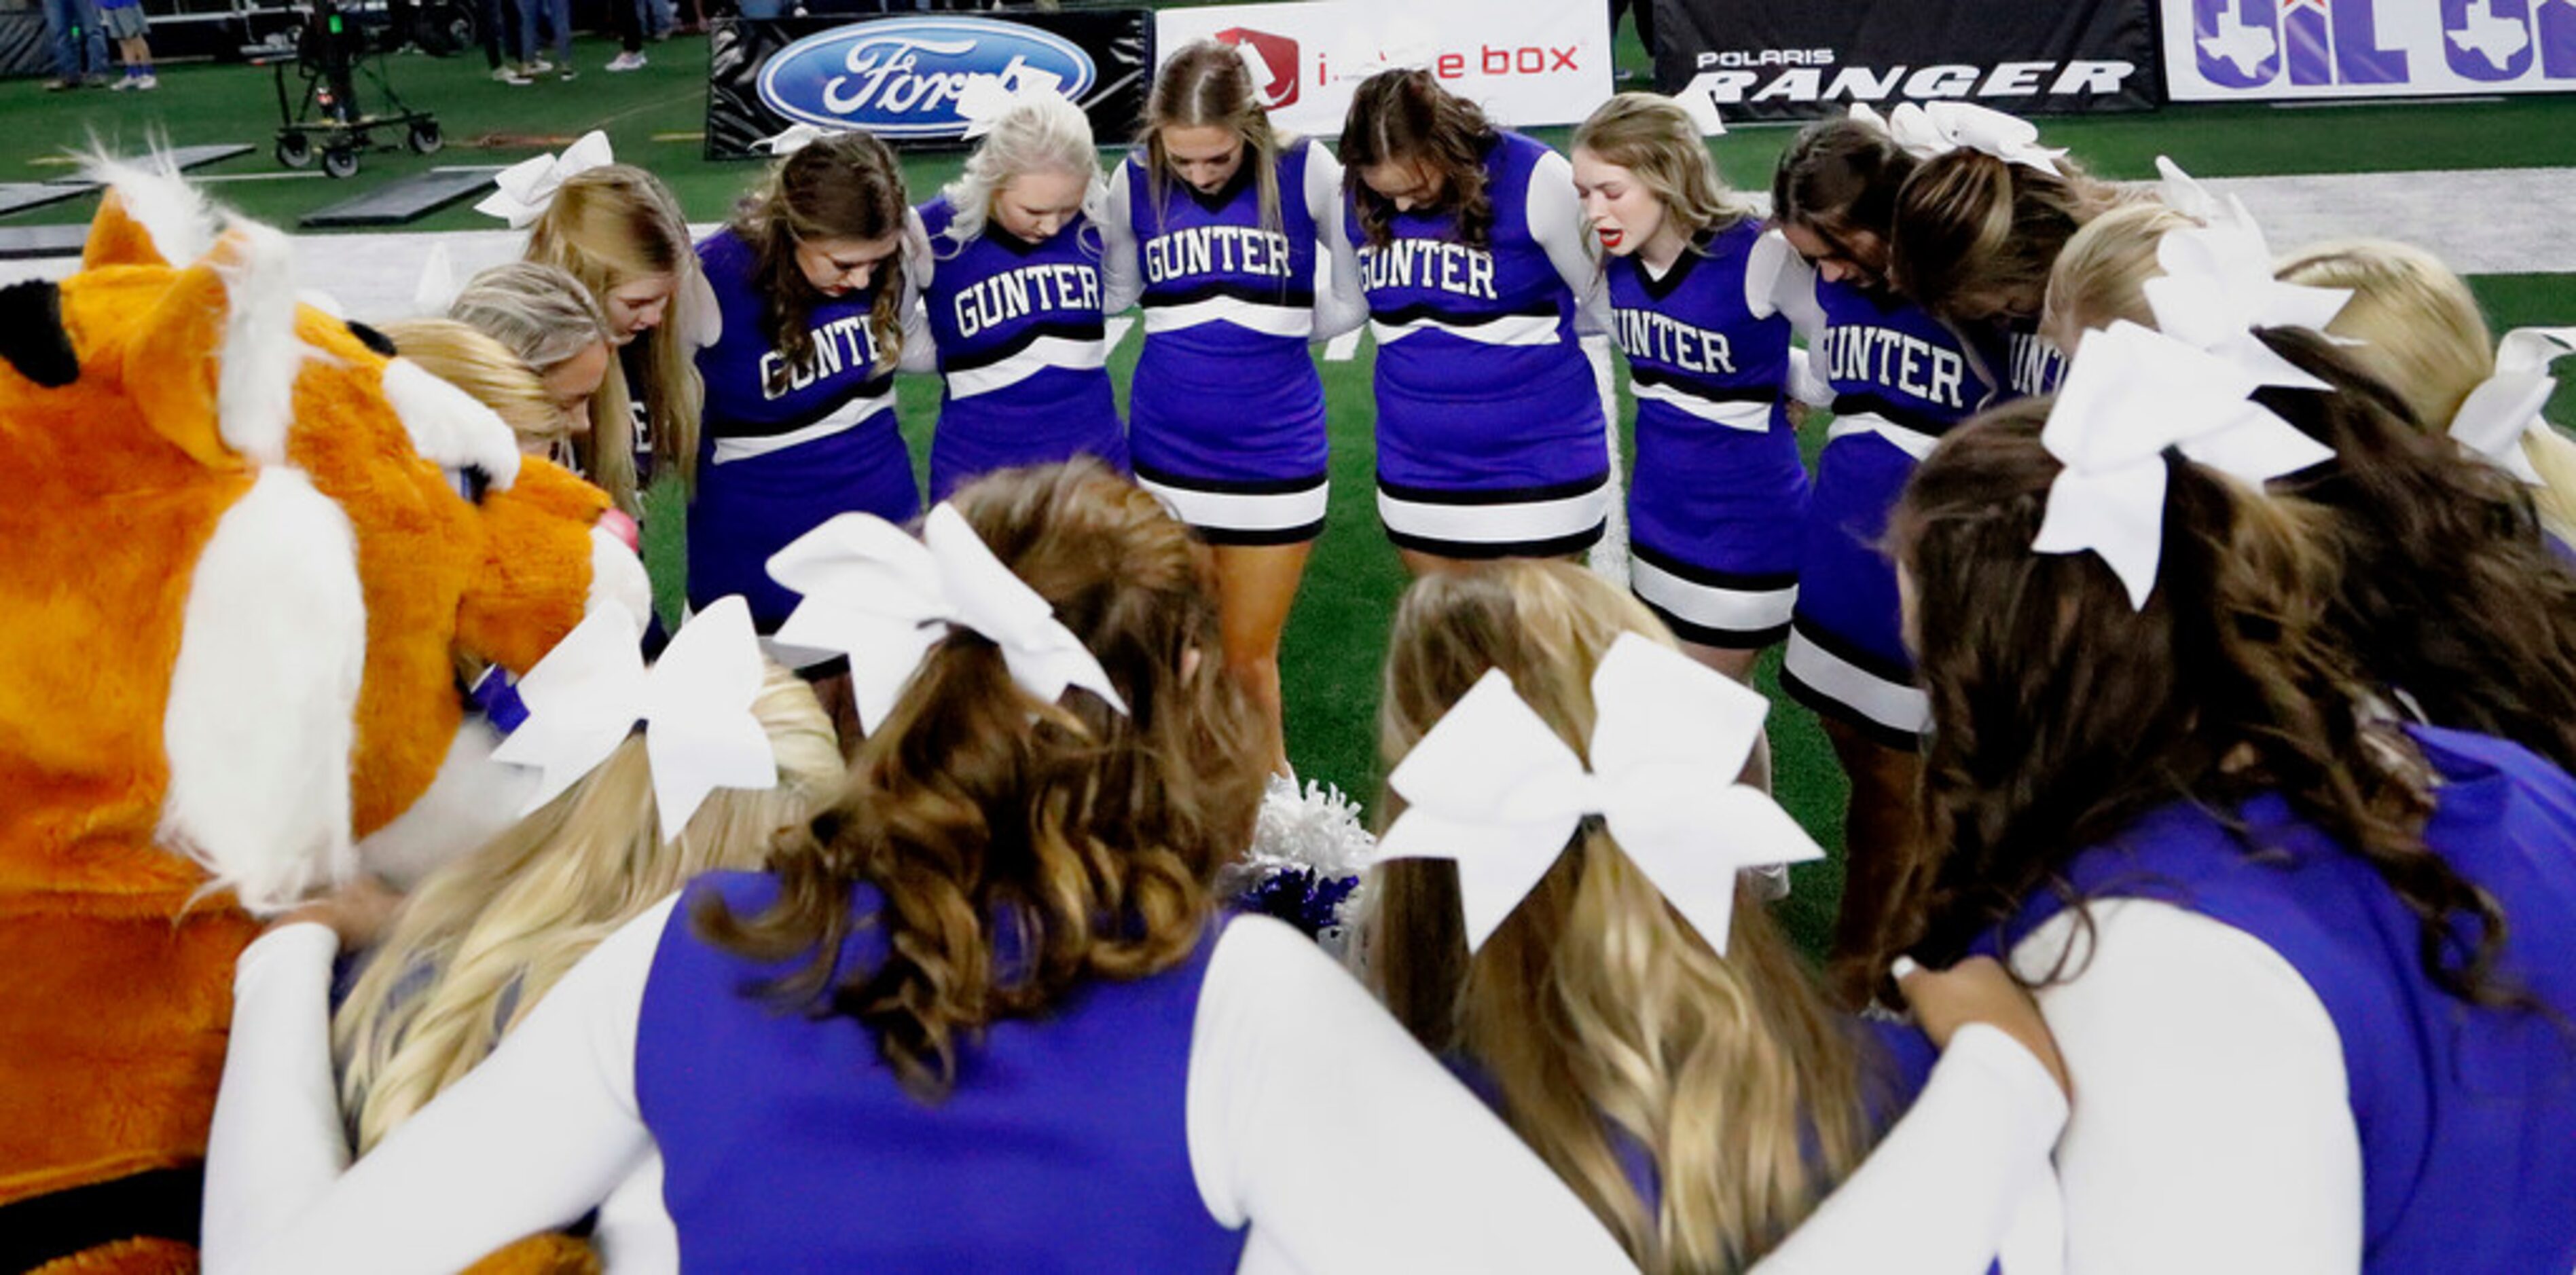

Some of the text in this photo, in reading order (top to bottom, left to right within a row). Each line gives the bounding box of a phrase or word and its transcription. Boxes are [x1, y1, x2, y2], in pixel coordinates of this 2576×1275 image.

[1482, 44, 1578, 75] box
[1680, 60, 2135, 103] RANGER
[1697, 48, 1835, 69] POLARIS
[1146, 225, 1292, 283] GUNTER
[954, 264, 1100, 337] GUNTER
[759, 315, 881, 401] GUNTE
[1614, 309, 1737, 373] UNTER
[1825, 325, 1963, 408] UNTER
